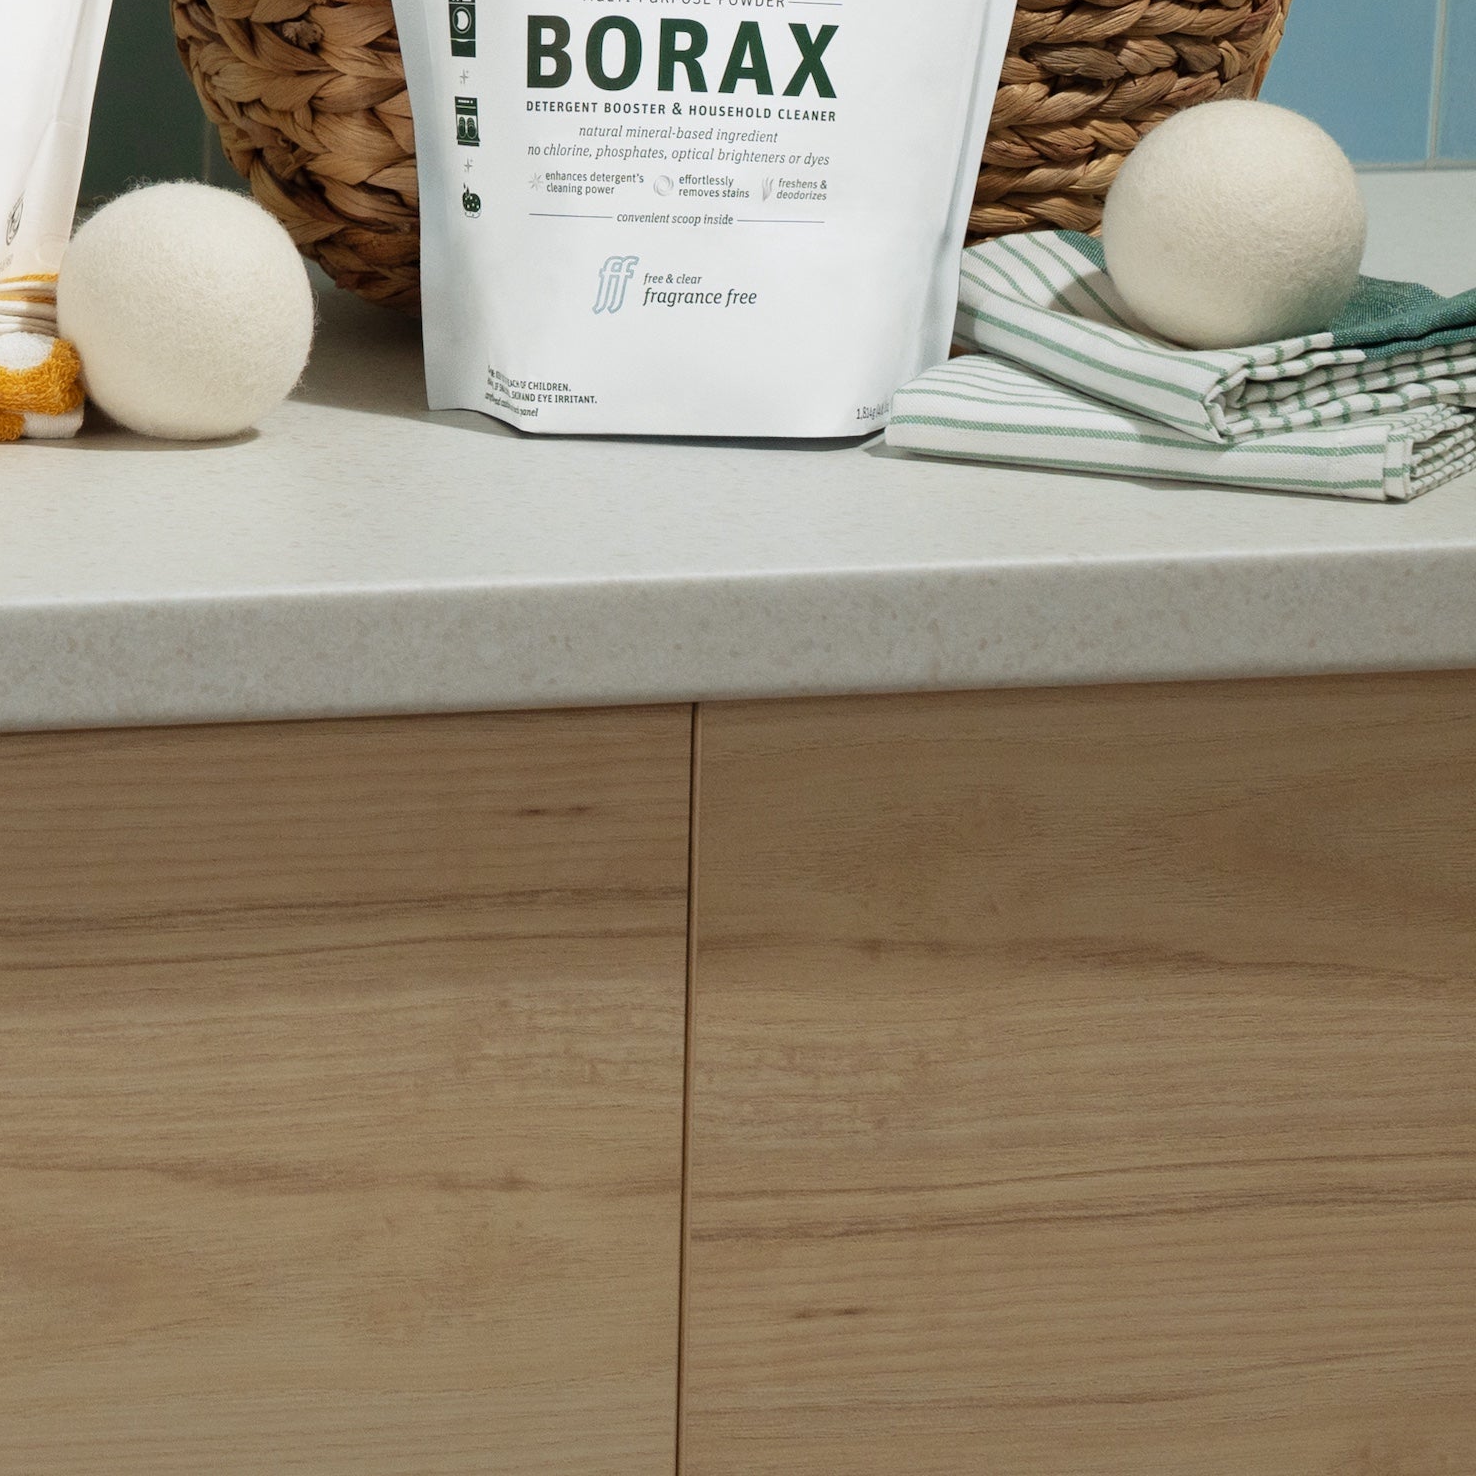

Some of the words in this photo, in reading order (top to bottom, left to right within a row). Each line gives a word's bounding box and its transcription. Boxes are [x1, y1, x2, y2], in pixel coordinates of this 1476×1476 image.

[526, 14, 840, 98] BORAX
[527, 101, 598, 112] DETERGENT
[604, 103, 665, 114] BOOSTER
[672, 104, 682, 115] &
[689, 105, 771, 118] HOUSEHOLD
[778, 109, 835, 121] CLEANER
[579, 126, 623, 137] natural
[626, 127, 713, 140] mineral-based
[716, 129, 778, 144] ingredient
[528, 146, 541, 155] no
[544, 144, 592, 157] chlorine,
[595, 145, 667, 160] phosphates,
[672, 148, 714, 162] optical
[718, 149, 785, 164] brighteners
[789, 155, 801, 164] or
[804, 152, 829, 167] dyes
[546, 171, 587, 181] enhances
[590, 172, 644, 184] detergent's
[679, 174, 734, 188] effortlessly
[779, 179, 817, 189] freshens
[820, 180, 827, 189] &
[547, 183, 582, 195] cleaning
[585, 186, 614, 195] power
[679, 189, 719, 197] removes
[722, 188, 749, 198] stains
[776, 190, 826, 200] deodorizes
[617, 213, 670, 223] convenient
[672, 215, 701, 226] scoop
[704, 214, 733, 225] inside
[643, 273, 663, 285] free
[666, 274, 673, 284] &
[676, 274, 702, 284] clear
[643, 287, 722, 307] fragrance
[725, 289, 757, 307] free
[528, 382, 571, 391] CHILDREN.
[538, 394, 553, 402] EYE
